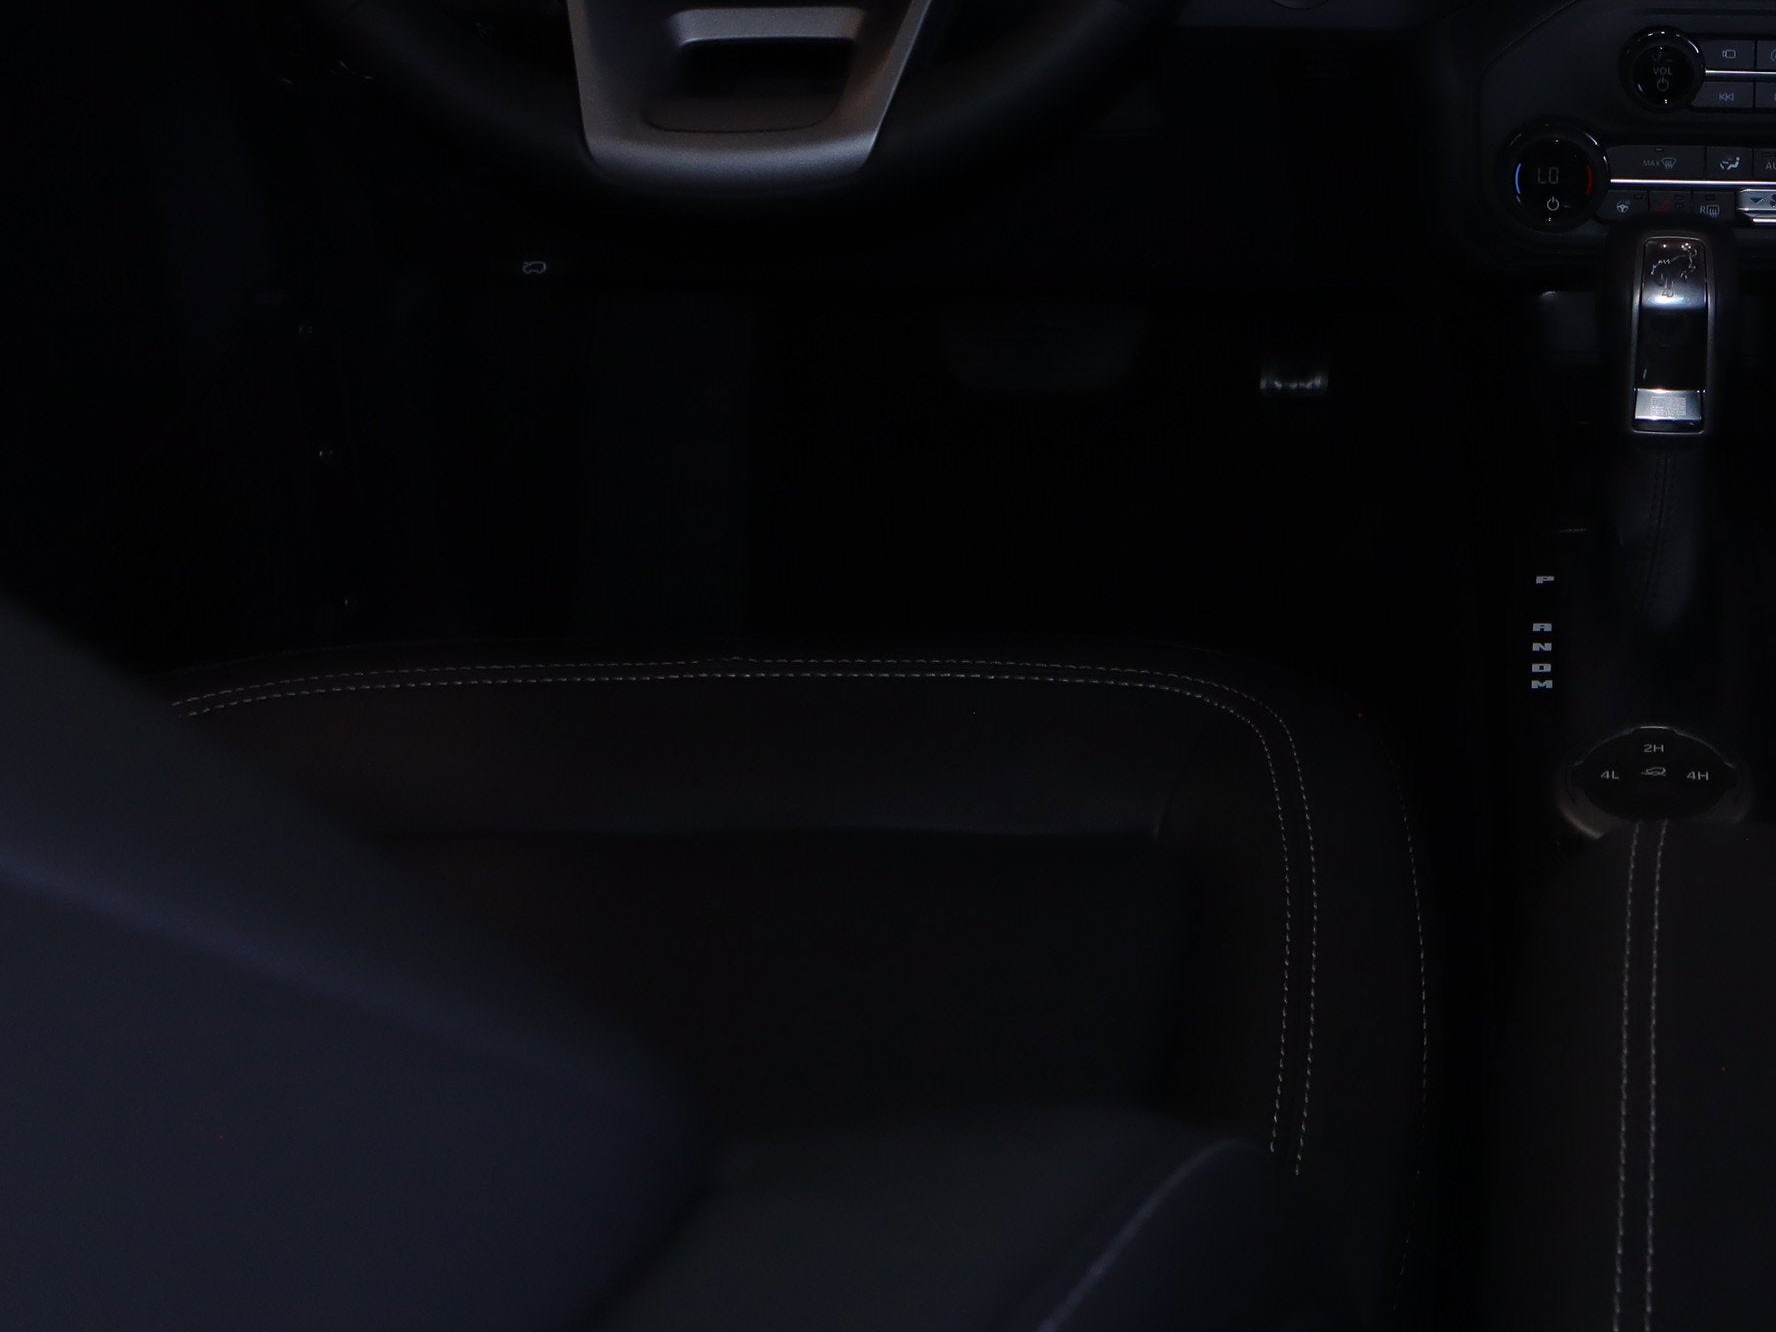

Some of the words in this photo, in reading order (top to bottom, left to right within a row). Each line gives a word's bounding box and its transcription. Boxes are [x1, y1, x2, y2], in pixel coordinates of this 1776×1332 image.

[1652, 67, 1673, 76] VOL
[1535, 575, 1555, 584] P
[1532, 643, 1552, 651] N
[1531, 663, 1552, 673] D
[1531, 679, 1553, 689] M
[1643, 744, 1664, 753] 2H
[1600, 771, 1620, 780] 4L
[1686, 771, 1709, 781] 4H
